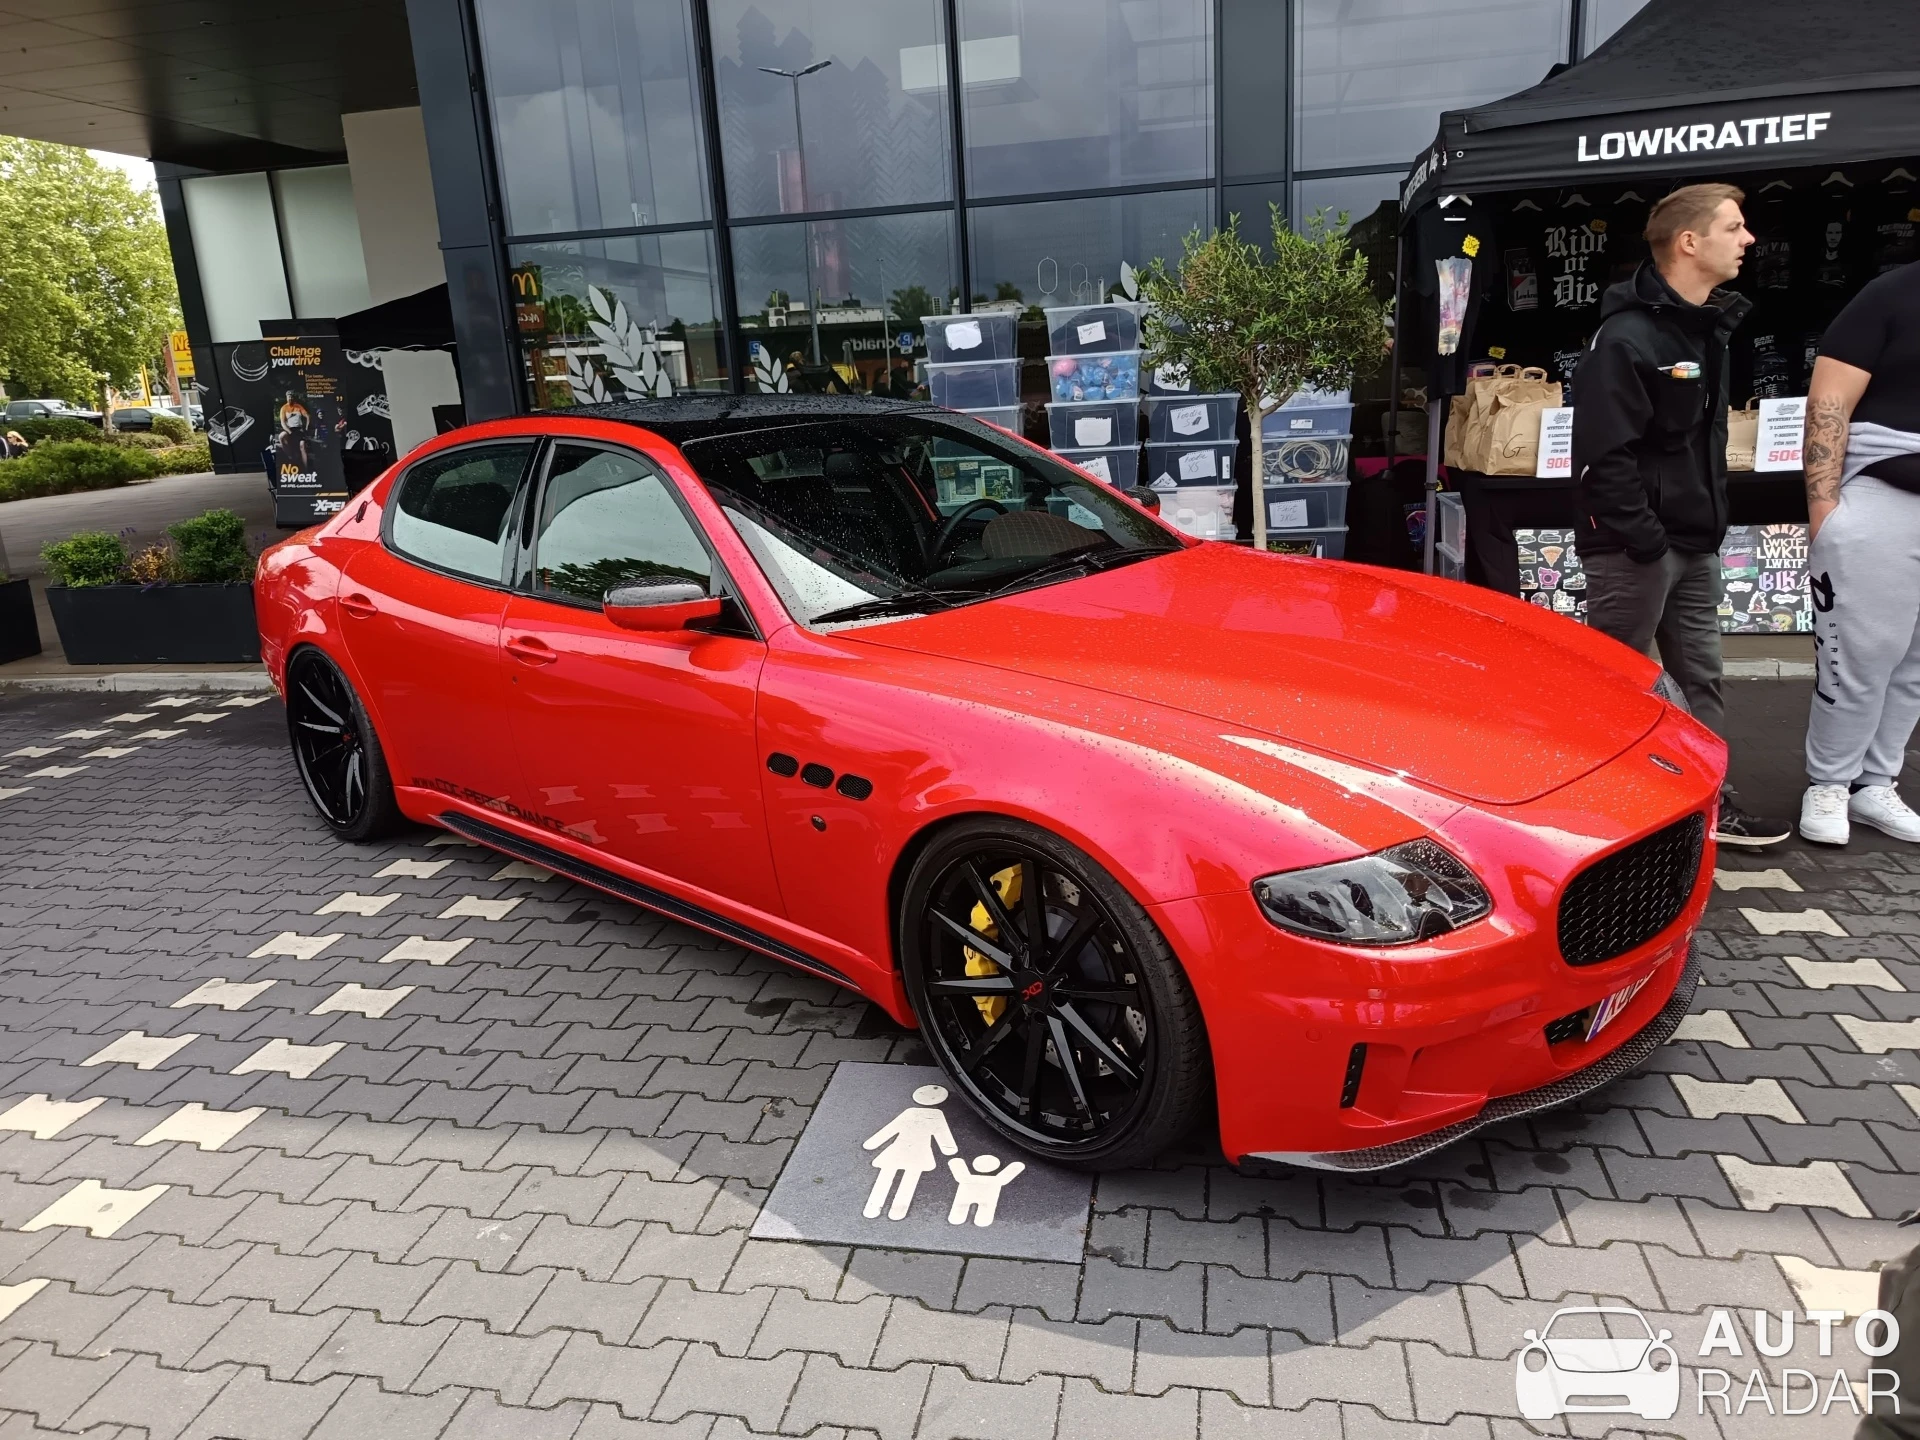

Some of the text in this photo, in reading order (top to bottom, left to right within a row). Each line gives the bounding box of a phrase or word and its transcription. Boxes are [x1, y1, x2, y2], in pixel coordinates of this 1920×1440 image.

[1578, 112, 1831, 162] LOWKRATIEF
[1545, 224, 1608, 258] Ride
[1564, 256, 1589, 273] or
[1553, 275, 1599, 308] Die
[270, 346, 321, 358] Challenge
[1768, 449, 1802, 462] 50€
[281, 463, 299, 474] No
[1546, 457, 1571, 469] 90€
[280, 471, 318, 483] sweat
